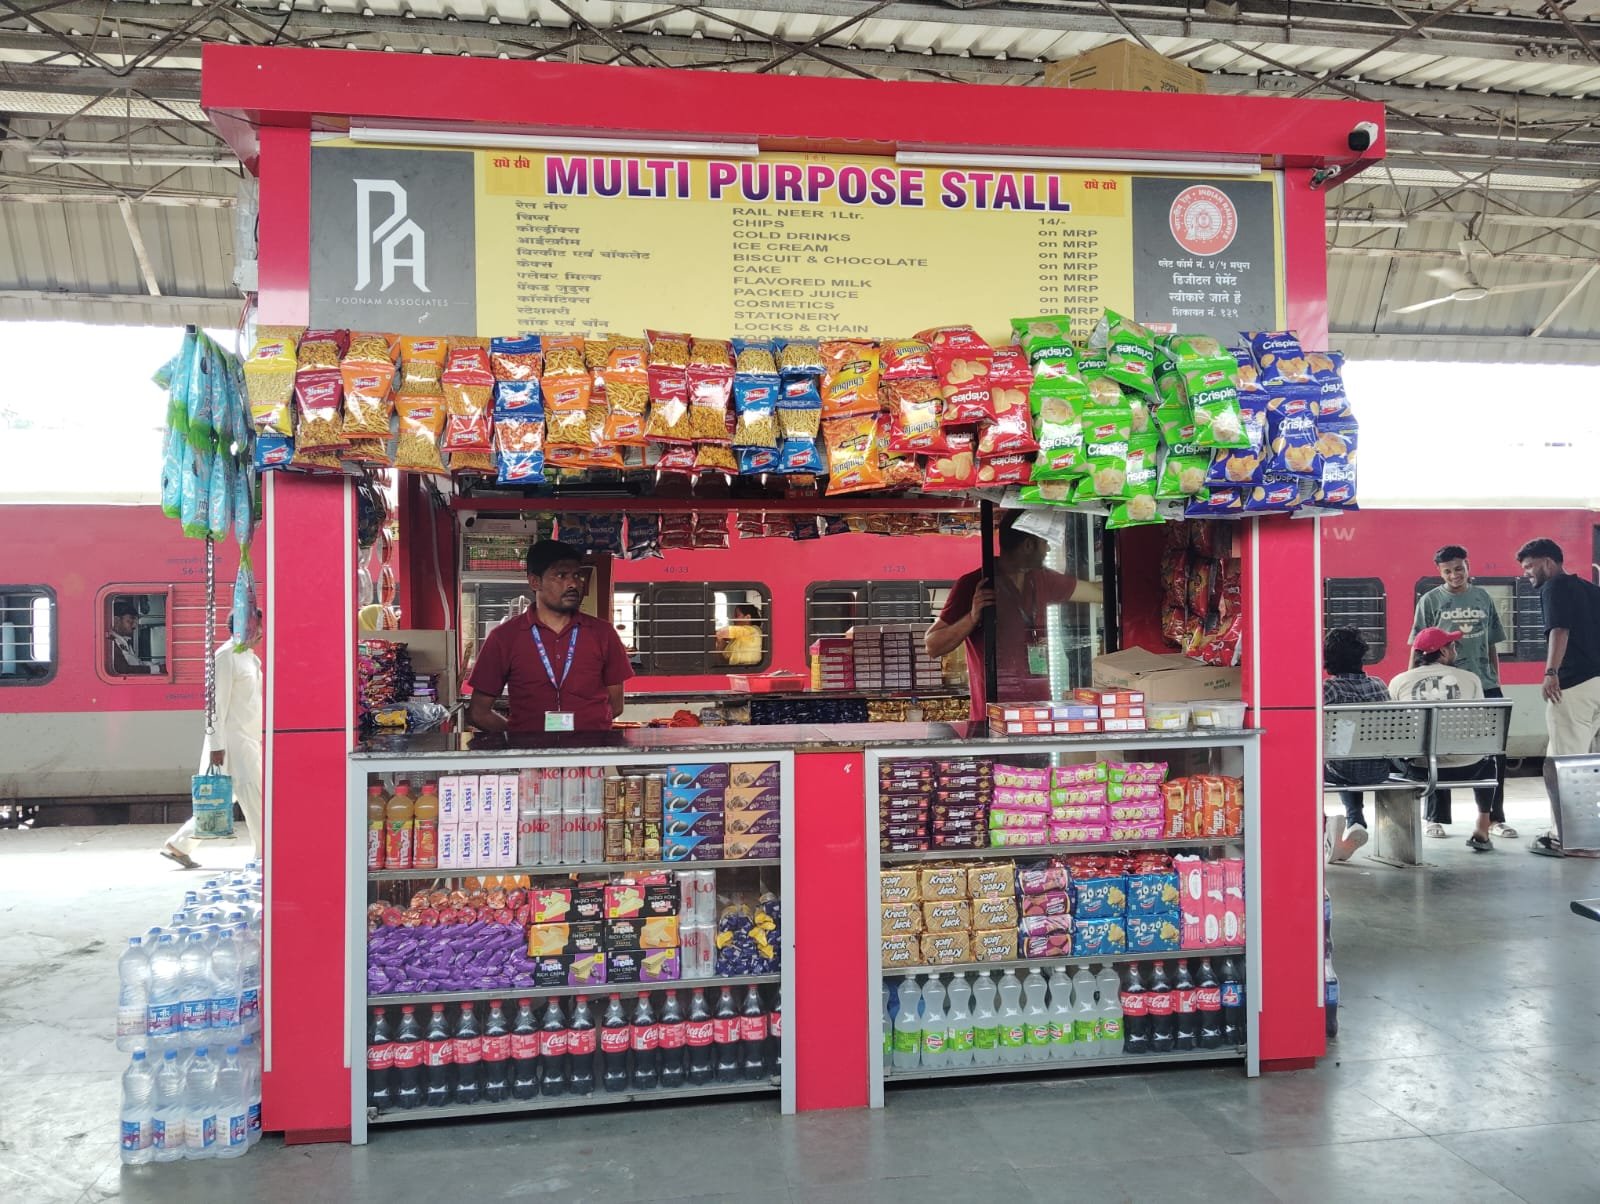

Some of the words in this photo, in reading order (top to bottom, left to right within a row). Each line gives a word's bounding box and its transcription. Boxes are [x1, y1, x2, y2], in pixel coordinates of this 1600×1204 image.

[493, 157, 510, 168] राधे
[514, 157, 531, 168] राधे
[546, 157, 691, 199] MULTI
[708, 161, 925, 207] PURPOSE
[940, 170, 1071, 213] STALL
[1084, 180, 1098, 190] राधे
[1101, 180, 1116, 191] राधे
[1198, 189, 1223, 204] INDIAN
[516, 201, 537, 209] रेल
[543, 202, 569, 210] नीर
[732, 207, 772, 216] RAIL
[777, 209, 824, 219] NEER
[830, 211, 865, 220] 1Ltr.
[732, 219, 785, 228] CHIPS
[1038, 217, 1067, 225] 14/-
[732, 230, 781, 240] COLD
[787, 232, 851, 242] DRINKS
[1063, 229, 1098, 238] MRP
[732, 242, 761, 251] ICE
[766, 244, 829, 253] CREAM
[1063, 240, 1098, 249] MRP
[732, 253, 802, 263] BISCUIT
[806, 255, 818, 264] &
[824, 256, 929, 267] CHOCOLATE
[1063, 251, 1098, 260] MRP
[732, 264, 781, 274] CAKE
[1063, 262, 1098, 271] MRP
[733, 276, 826, 287] FLAVORED
[830, 279, 873, 288] MILK
[1063, 273, 1098, 282] MRP
[733, 287, 804, 298] PACKED
[809, 290, 860, 299] JUICE
[1063, 284, 1098, 293] MRP
[335, 297, 382, 305] POONAM
[386, 298, 449, 306] ASSOCIATES
[733, 299, 835, 310] COSMETICS
[1064, 295, 1099, 304] MRP
[733, 311, 841, 321] STATIONERY
[1064, 306, 1099, 315] MRP
[733, 322, 794, 332] LOCKS
[799, 323, 811, 333] &
[815, 324, 869, 333] CHAIN
[1033, 346, 1073, 360] Crispies
[1116, 344, 1153, 360] Crispies
[951, 391, 990, 404] Crispies
[1441, 607, 1486, 620] adidas
[484, 787, 492, 810] Lassi
[463, 833, 471, 858] Lassi
[883, 877, 900, 887] Jack
[930, 873, 955, 884] Krack
[979, 872, 998, 882] Jack
[886, 887, 910, 898] Krack
[939, 887, 957, 896] Jack
[983, 882, 1007, 893] Krack
[1136, 883, 1163, 900] 20-20
[1082, 887, 1109, 902] 20-20
[884, 906, 908, 918] Krack
[933, 906, 957, 917] Krack
[981, 904, 1005, 914] Krack
[893, 919, 912, 929] Jack
[942, 918, 961, 928] Jack
[990, 916, 1009, 927] Jack
[1082, 923, 1109, 939] 20-20
[1135, 920, 1161, 936] 20-20
[882, 940, 907, 951] Krack
[935, 938, 954, 949] Jack
[983, 936, 1002, 947] Jack
[891, 952, 910, 962] Jack
[939, 949, 962, 960] Krack
[986, 947, 1011, 957] Krack
